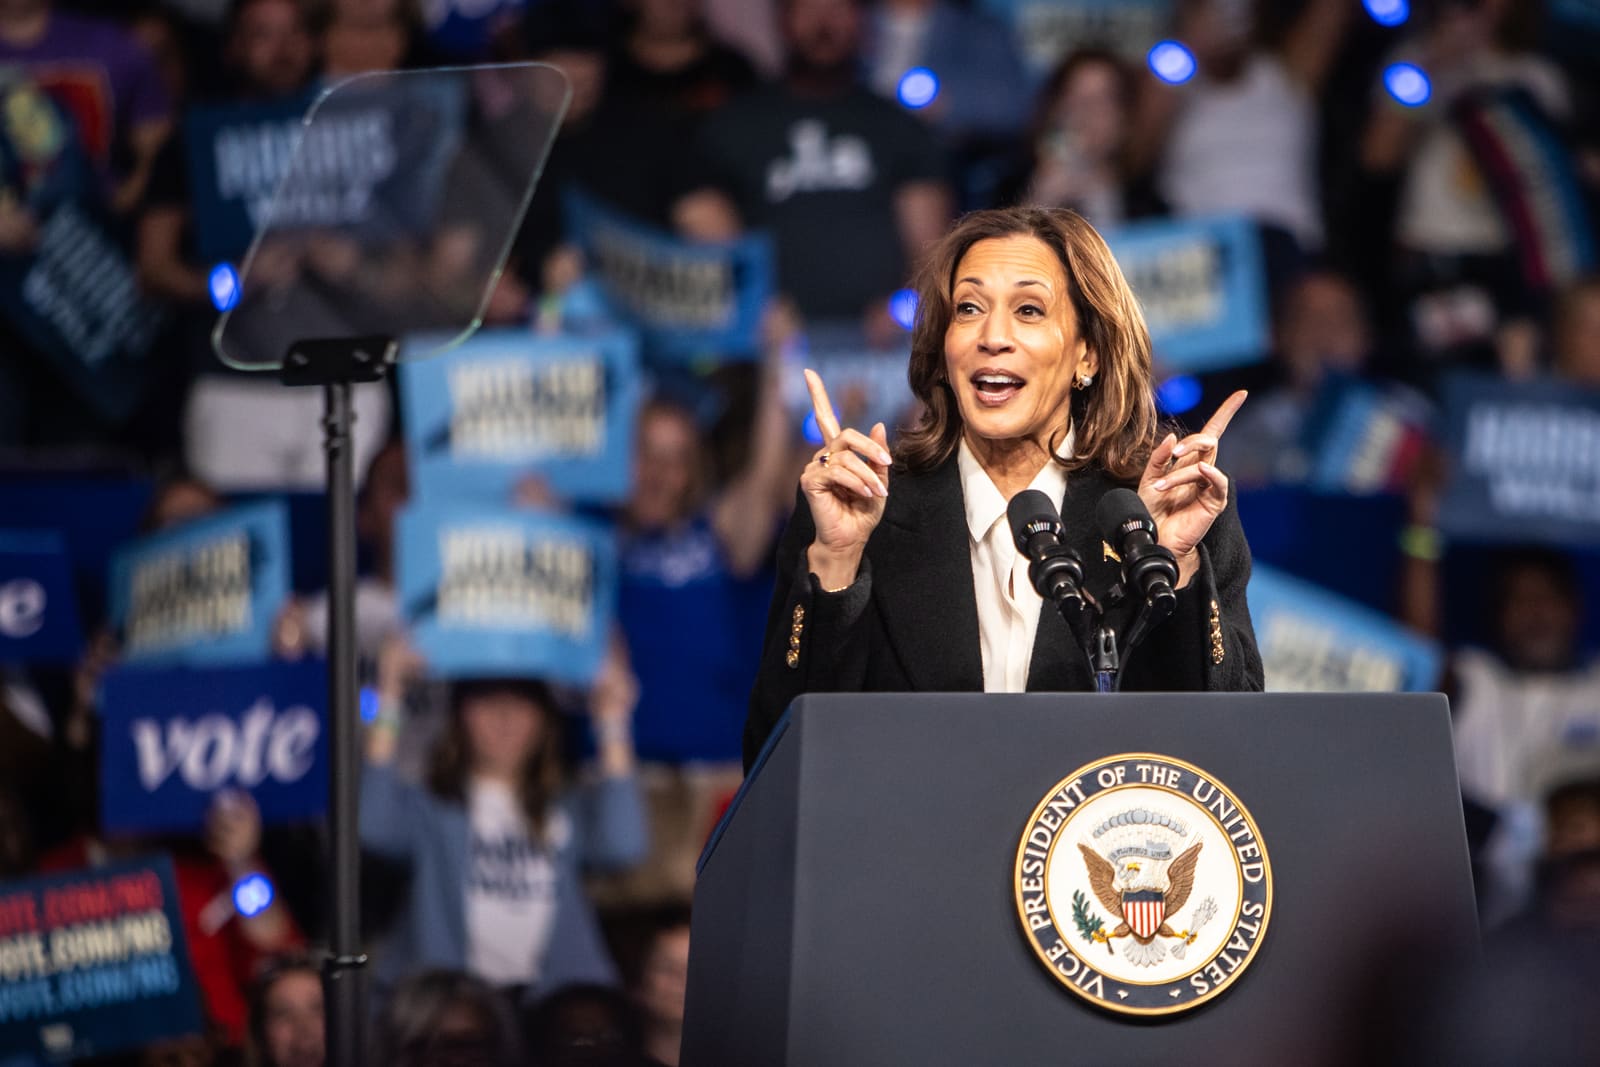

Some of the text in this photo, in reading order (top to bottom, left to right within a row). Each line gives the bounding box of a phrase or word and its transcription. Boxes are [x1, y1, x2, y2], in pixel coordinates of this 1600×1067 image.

[133, 696, 320, 792] vote
[1022, 764, 1265, 1000] VICE PRESIDENT OF THE UNITED STATES
